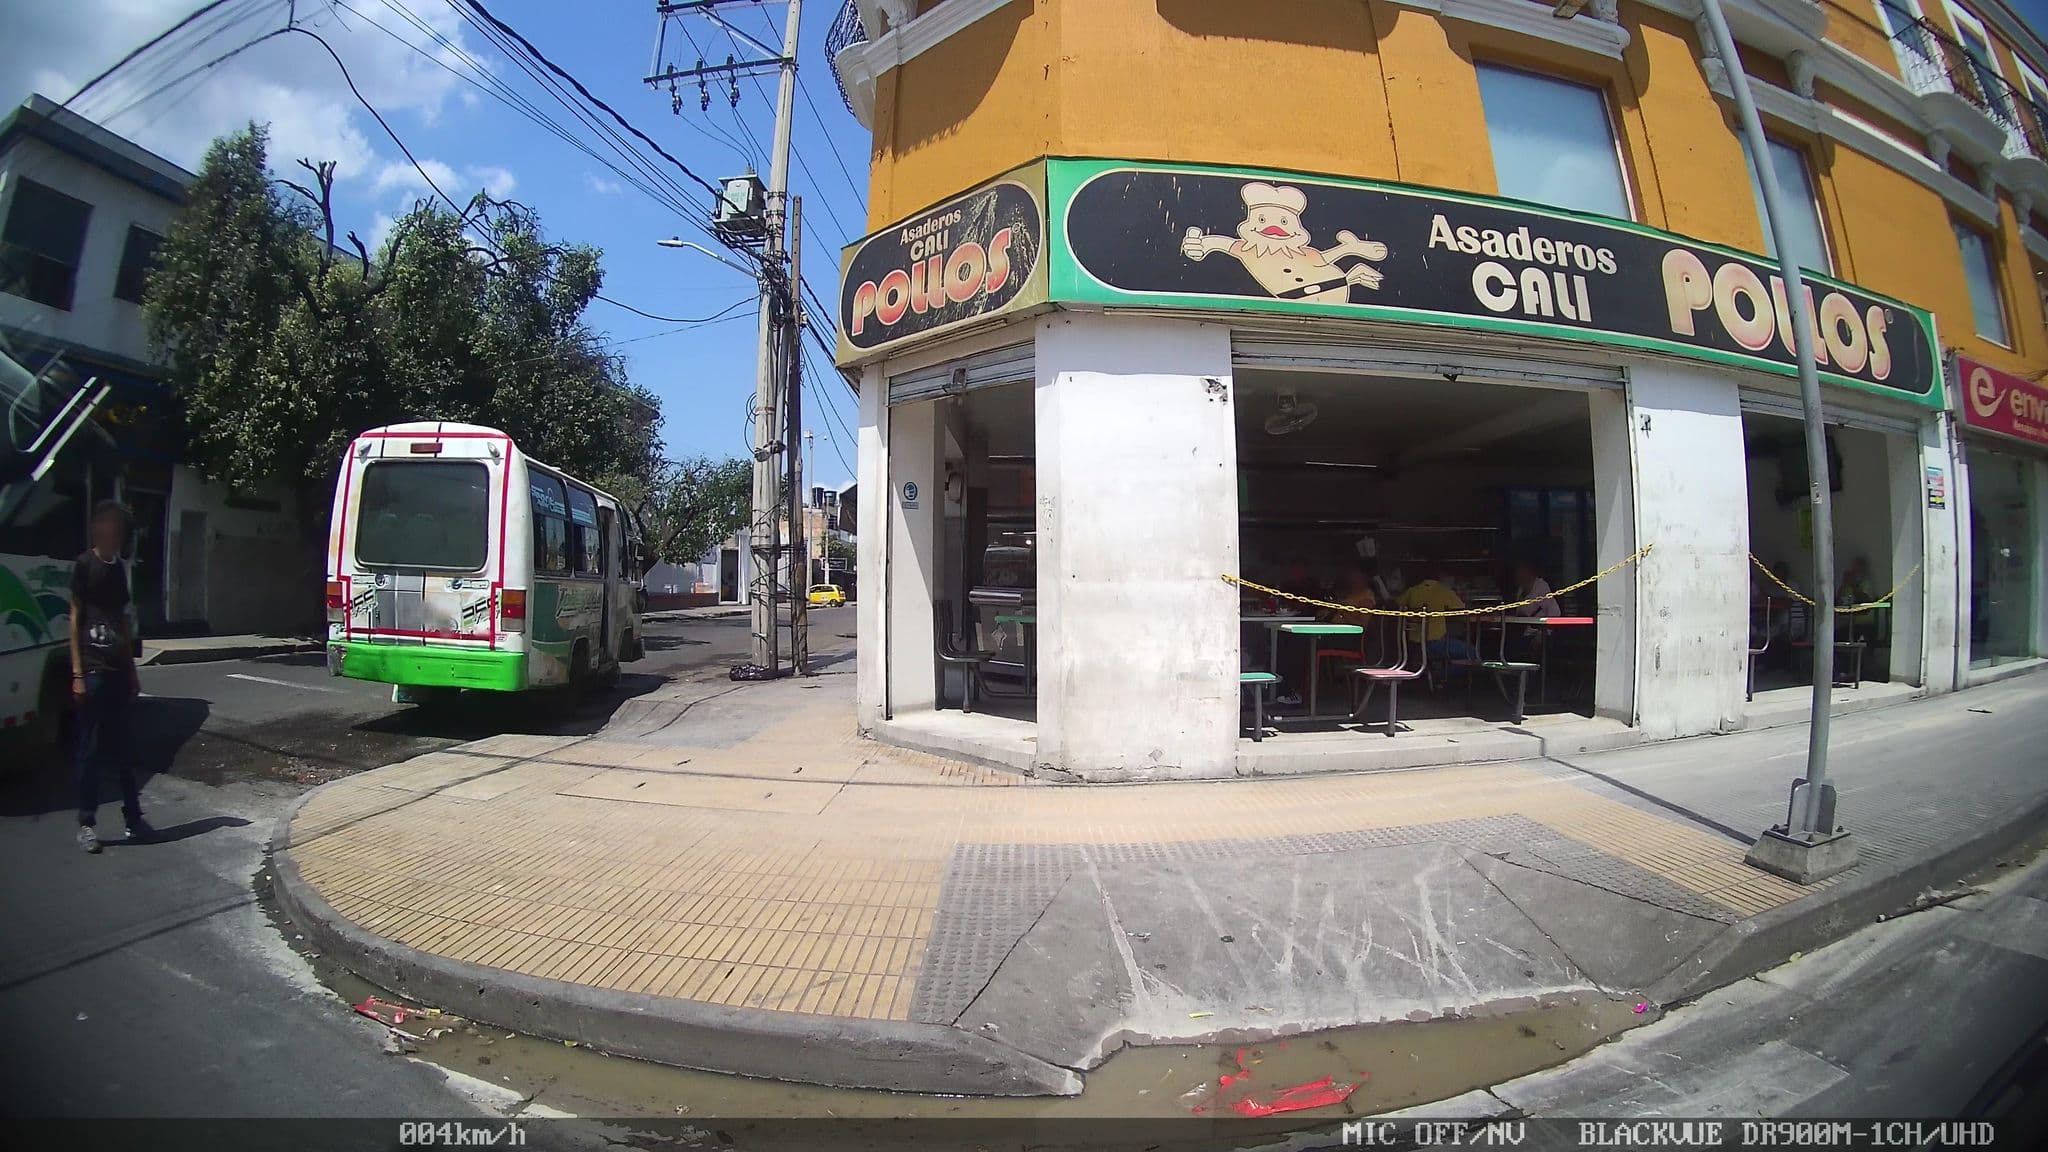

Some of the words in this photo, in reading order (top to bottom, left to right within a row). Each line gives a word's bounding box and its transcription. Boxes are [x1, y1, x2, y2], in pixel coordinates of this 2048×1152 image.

[899, 208, 962, 246] Asaderos
[909, 229, 950, 262] CALI
[1427, 213, 1618, 275] Asaderos
[851, 226, 1012, 337] POLLOS
[1471, 260, 1593, 323] CALI
